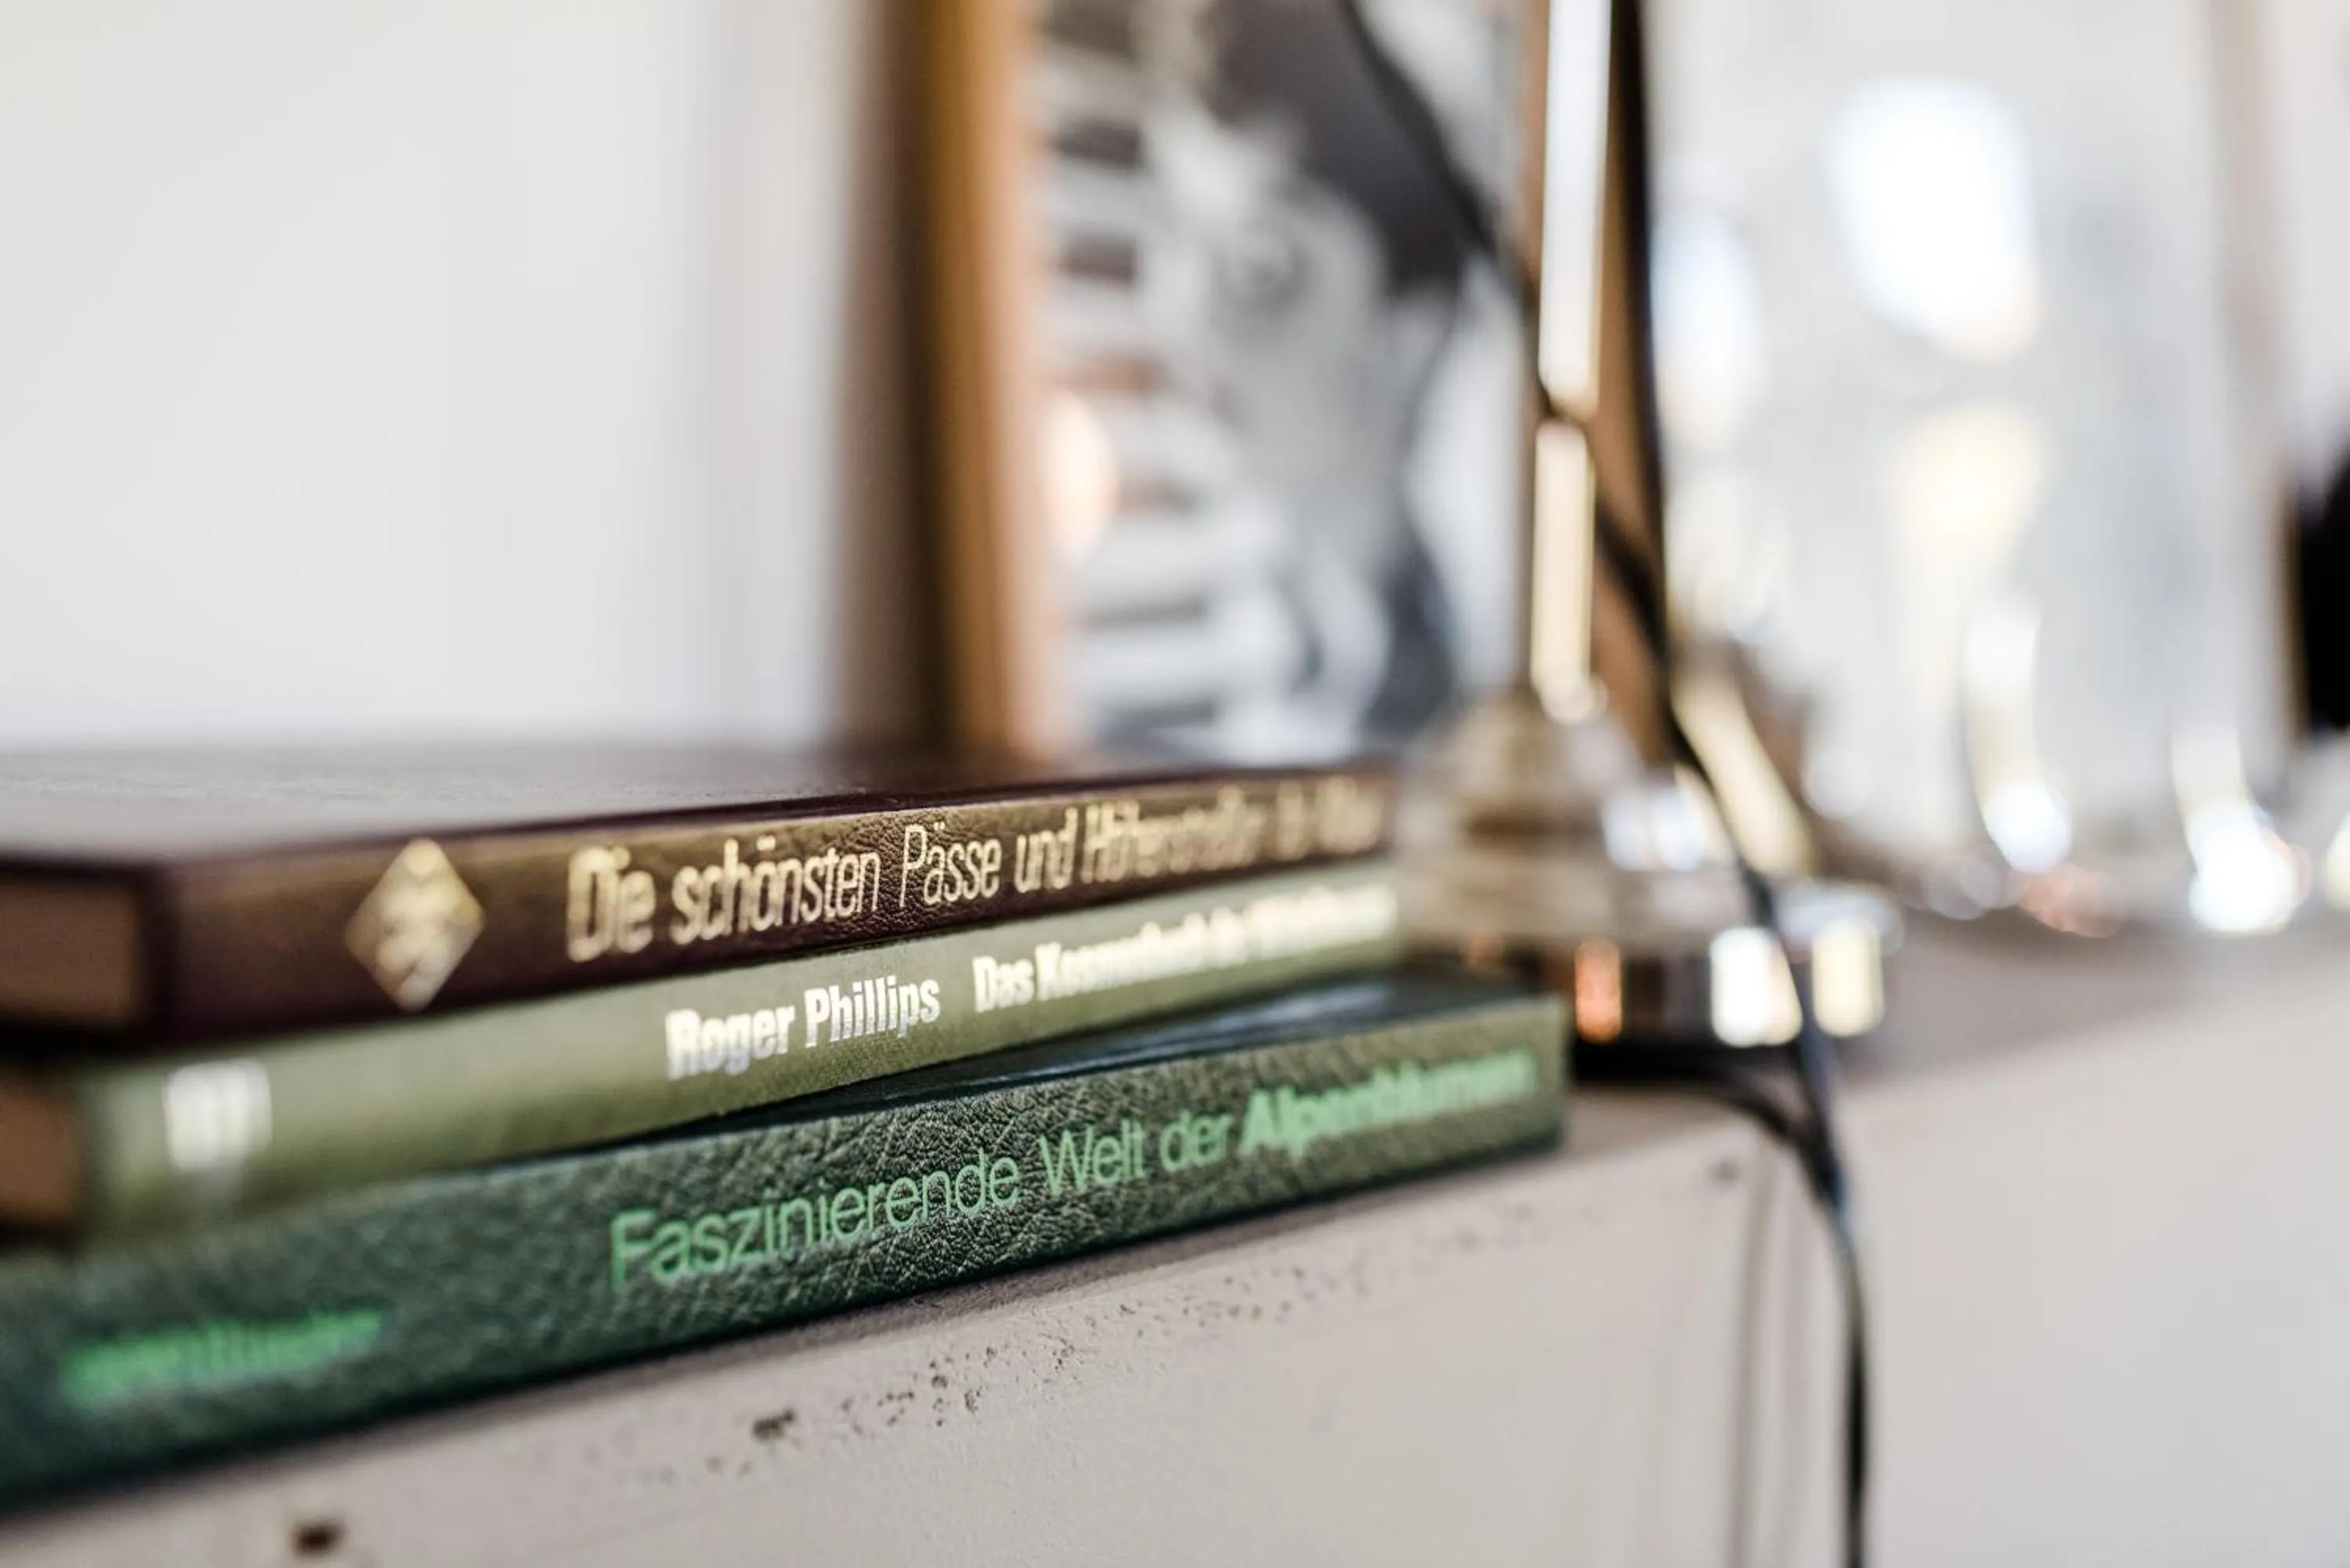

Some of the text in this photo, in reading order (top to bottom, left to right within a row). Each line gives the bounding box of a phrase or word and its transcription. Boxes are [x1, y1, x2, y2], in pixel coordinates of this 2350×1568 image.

[566, 844, 656, 963] Die
[670, 835, 880, 945] schönsten
[899, 822, 1001, 909] Pässe
[1013, 806, 1078, 894] und
[666, 976, 940, 1081] Roger Phillips
[972, 955, 1034, 1013] Das
[610, 1147, 1020, 1290] Faszinierende
[1038, 1118, 1146, 1196] Welt
[1159, 1101, 1233, 1172] der
